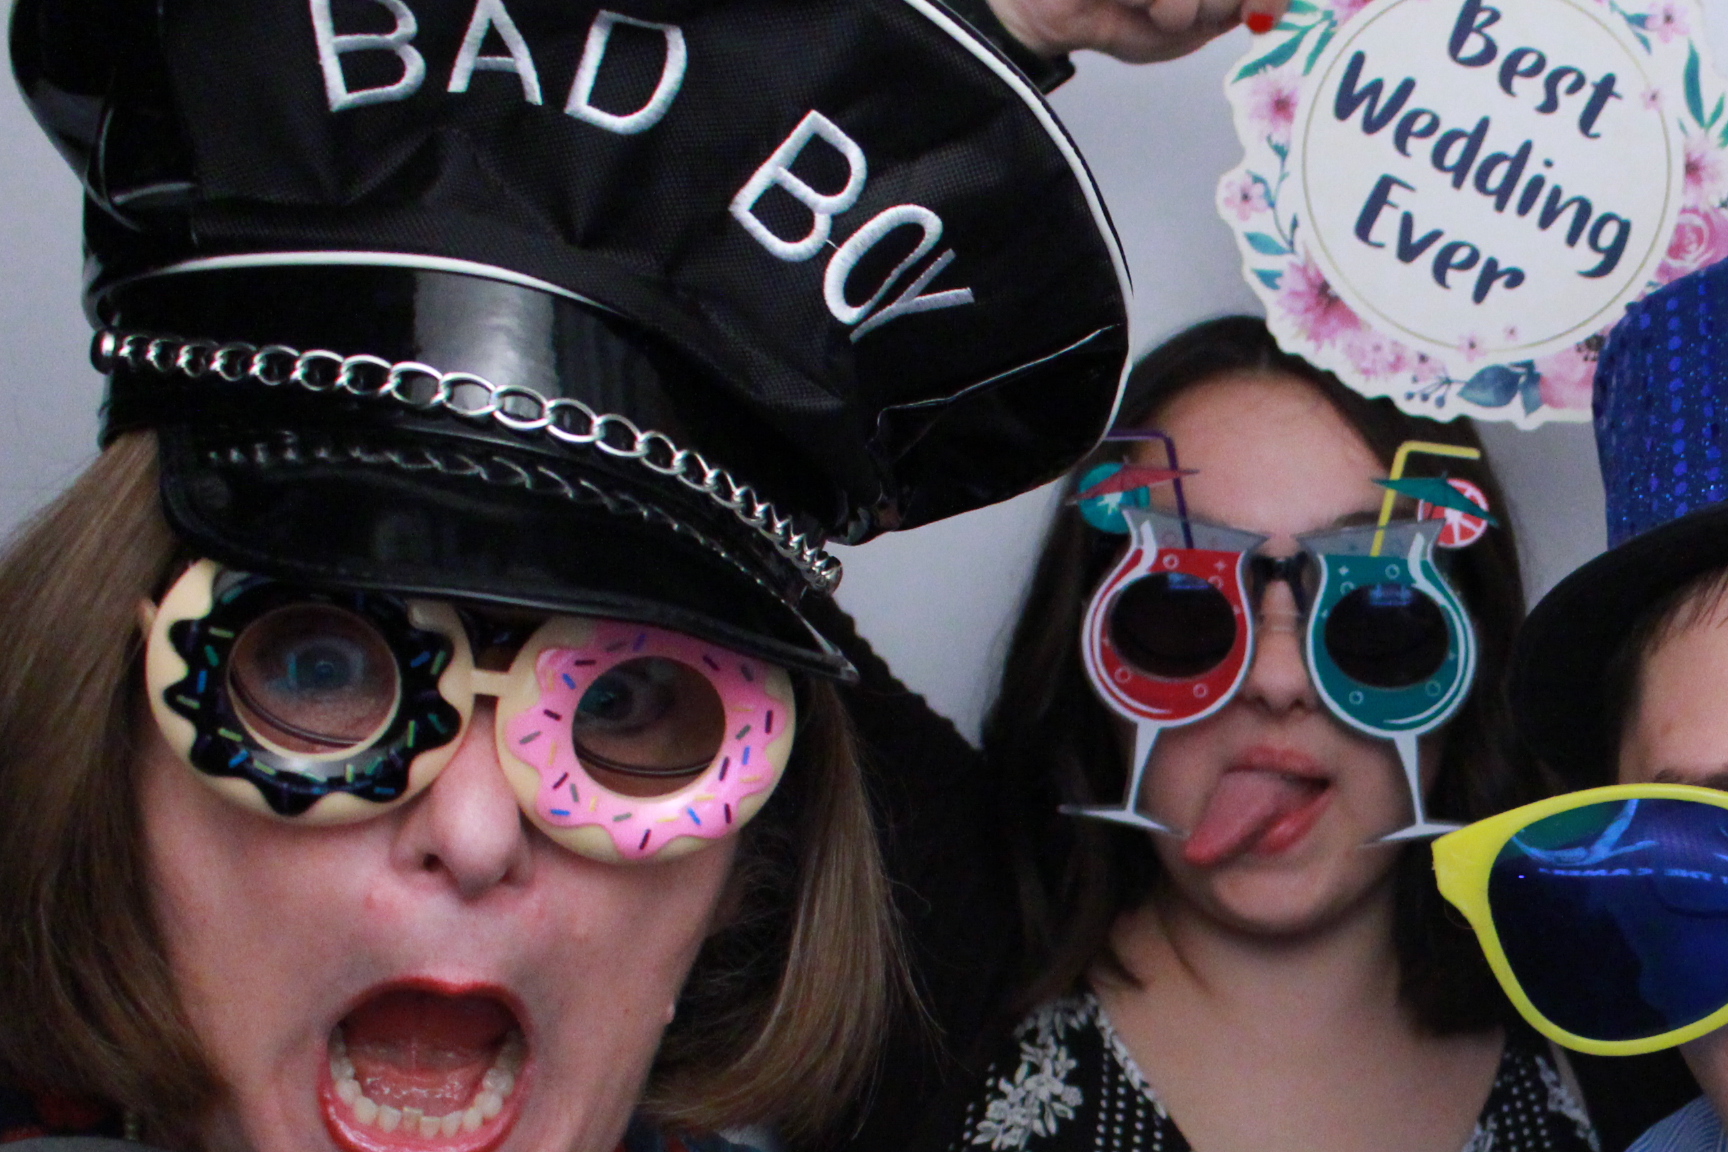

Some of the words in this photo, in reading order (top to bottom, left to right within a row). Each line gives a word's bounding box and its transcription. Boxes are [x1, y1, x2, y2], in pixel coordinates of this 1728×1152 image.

[1448, 0, 1624, 139] Best
[309, 0, 688, 135] BAD
[728, 108, 976, 344] BOY
[1333, 50, 1632, 280] Wedding
[1353, 173, 1526, 305] Ever
